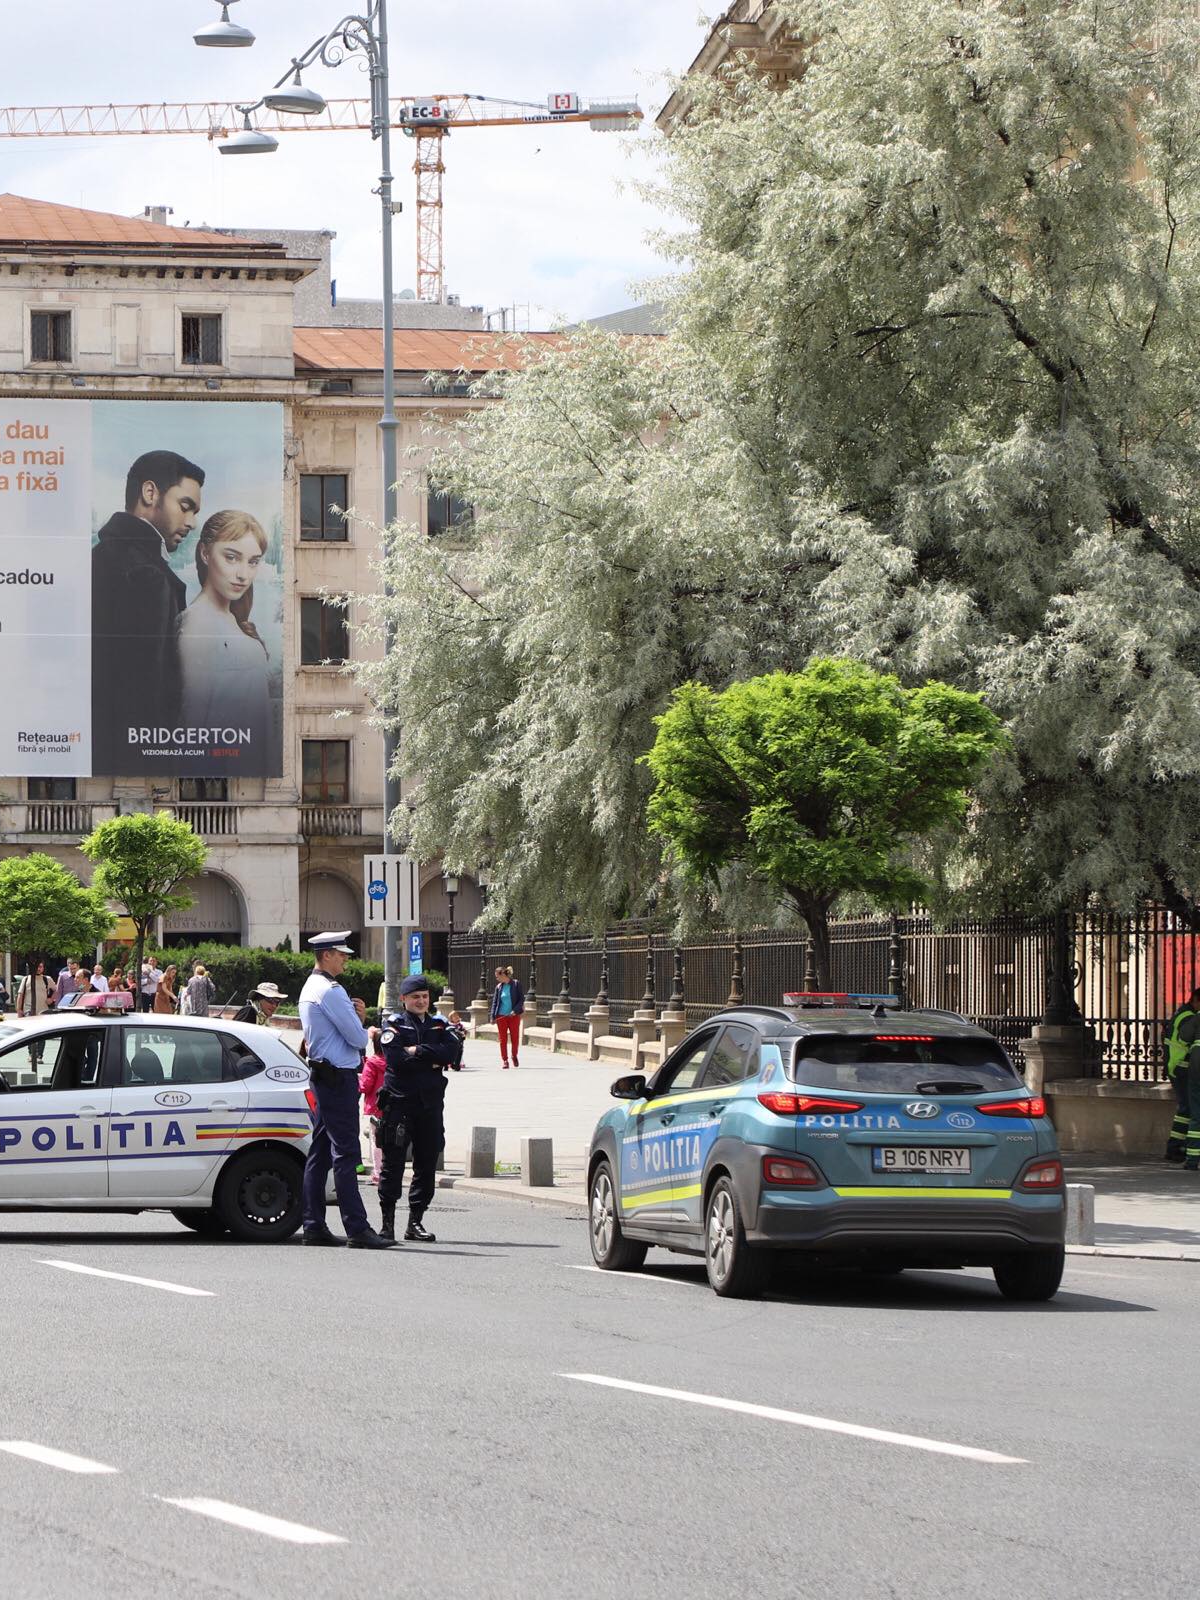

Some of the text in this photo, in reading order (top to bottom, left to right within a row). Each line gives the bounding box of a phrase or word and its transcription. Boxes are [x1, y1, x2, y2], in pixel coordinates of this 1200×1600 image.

[412, 106, 441, 118] EC-B
[6, 419, 49, 440] dau
[23, 446, 65, 466] mai
[16, 471, 58, 491] fixă
[128, 728, 251, 745] BRIDGERTON
[47, 745, 71, 753] mobil
[274, 1069, 301, 1079] B-004
[171, 1095, 184, 1103] 112
[805, 1115, 901, 1128] POLITIA
[644, 1135, 700, 1173] POLITIA
[885, 1150, 965, 1166] B 106 NRY
